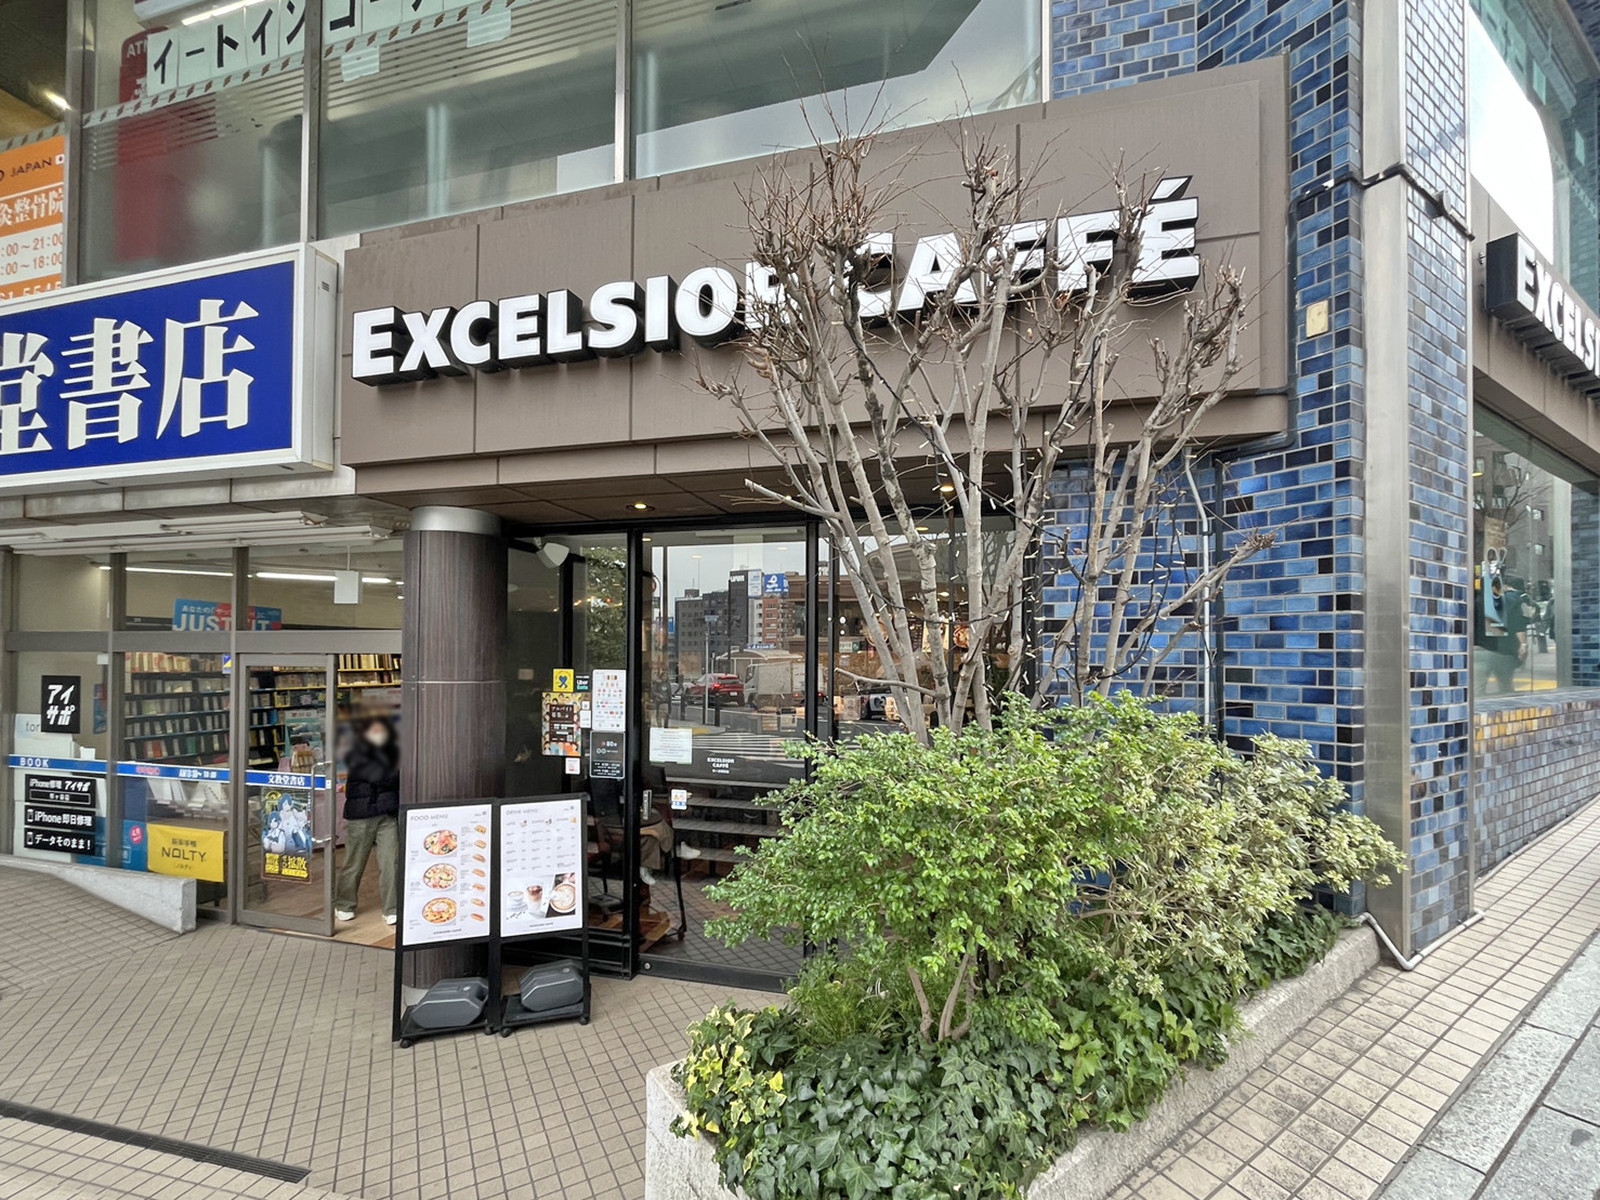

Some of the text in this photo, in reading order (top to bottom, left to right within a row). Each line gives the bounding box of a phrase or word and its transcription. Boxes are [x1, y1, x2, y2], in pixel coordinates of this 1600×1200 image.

[10, 157, 52, 178] JAPAN
[352, 175, 1199, 379] EXCELSIOR CAFFÉ
[48, 684, 75, 704] アイ
[46, 705, 75, 725] サポ
[20, 757, 49, 768] BOOK
[161, 846, 206, 863] NOLTY
